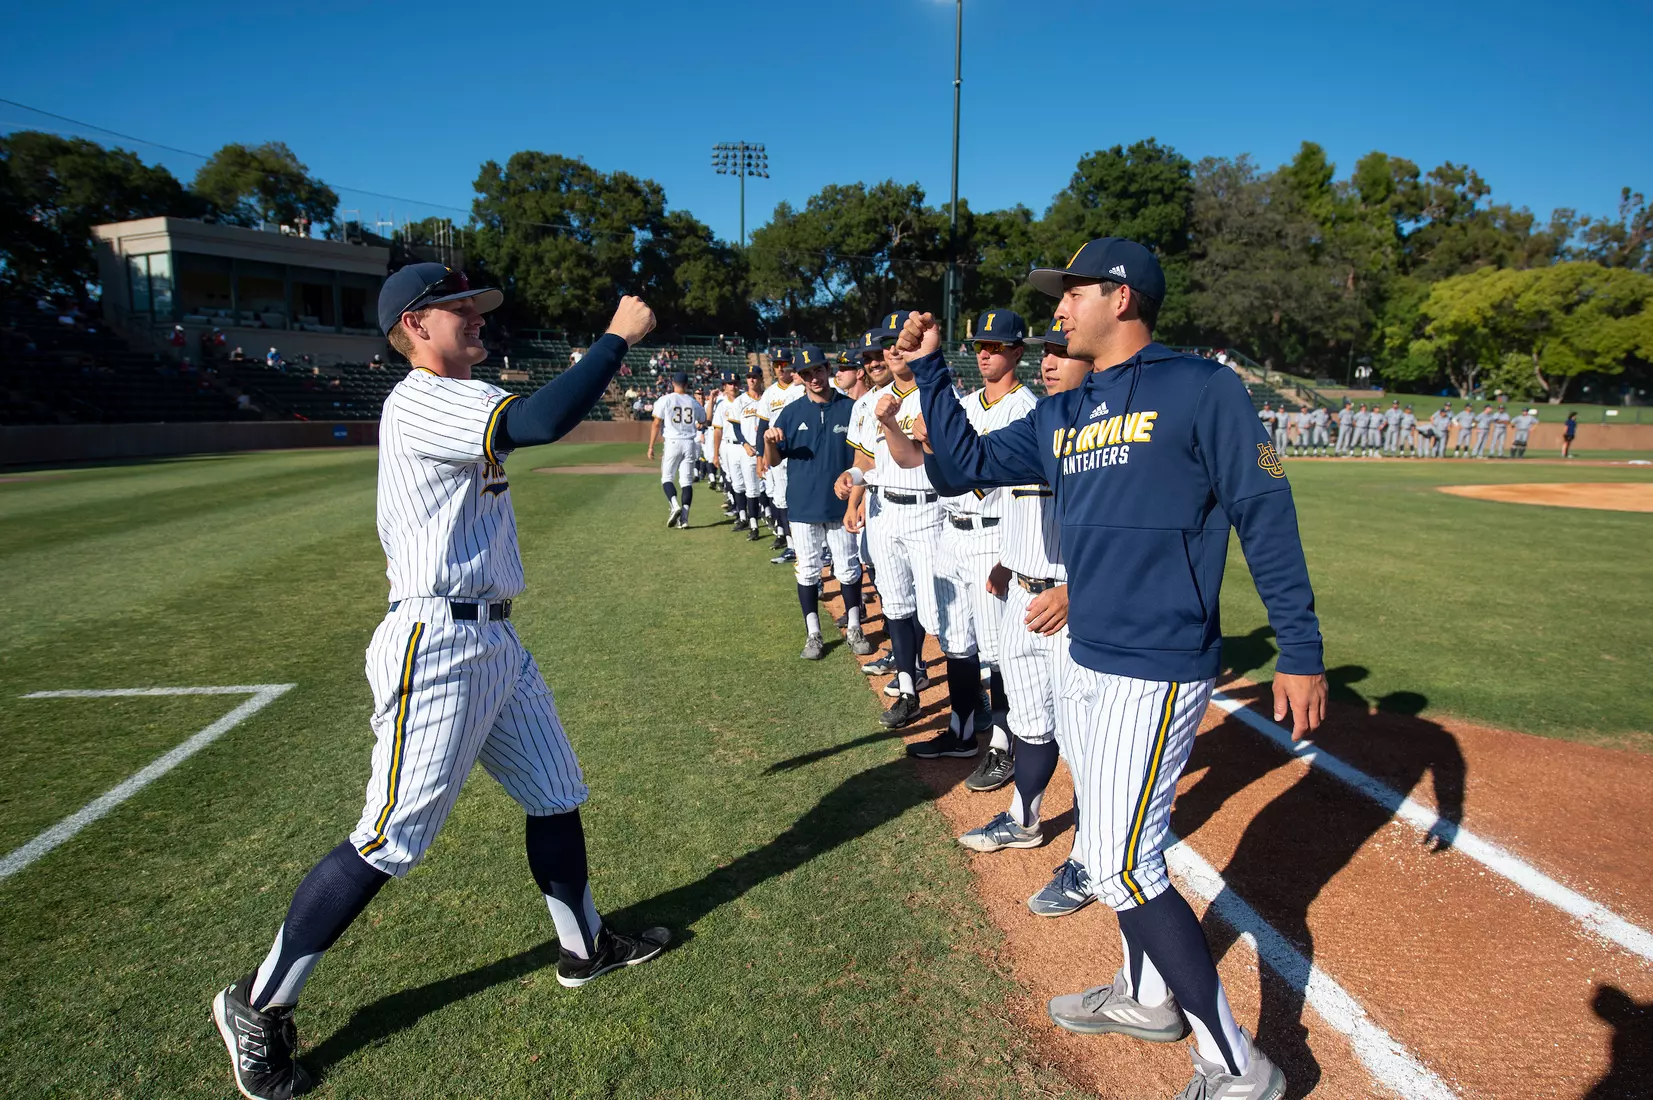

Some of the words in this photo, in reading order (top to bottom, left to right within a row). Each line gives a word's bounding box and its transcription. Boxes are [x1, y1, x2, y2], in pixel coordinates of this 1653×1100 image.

[889, 313, 899, 330] I
[983, 313, 996, 331] I
[865, 332, 872, 347] I
[802, 350, 811, 364] I
[672, 406, 693, 424] 33
[1075, 411, 1159, 453] IRVINE
[1063, 444, 1130, 476] ANTEATERS
